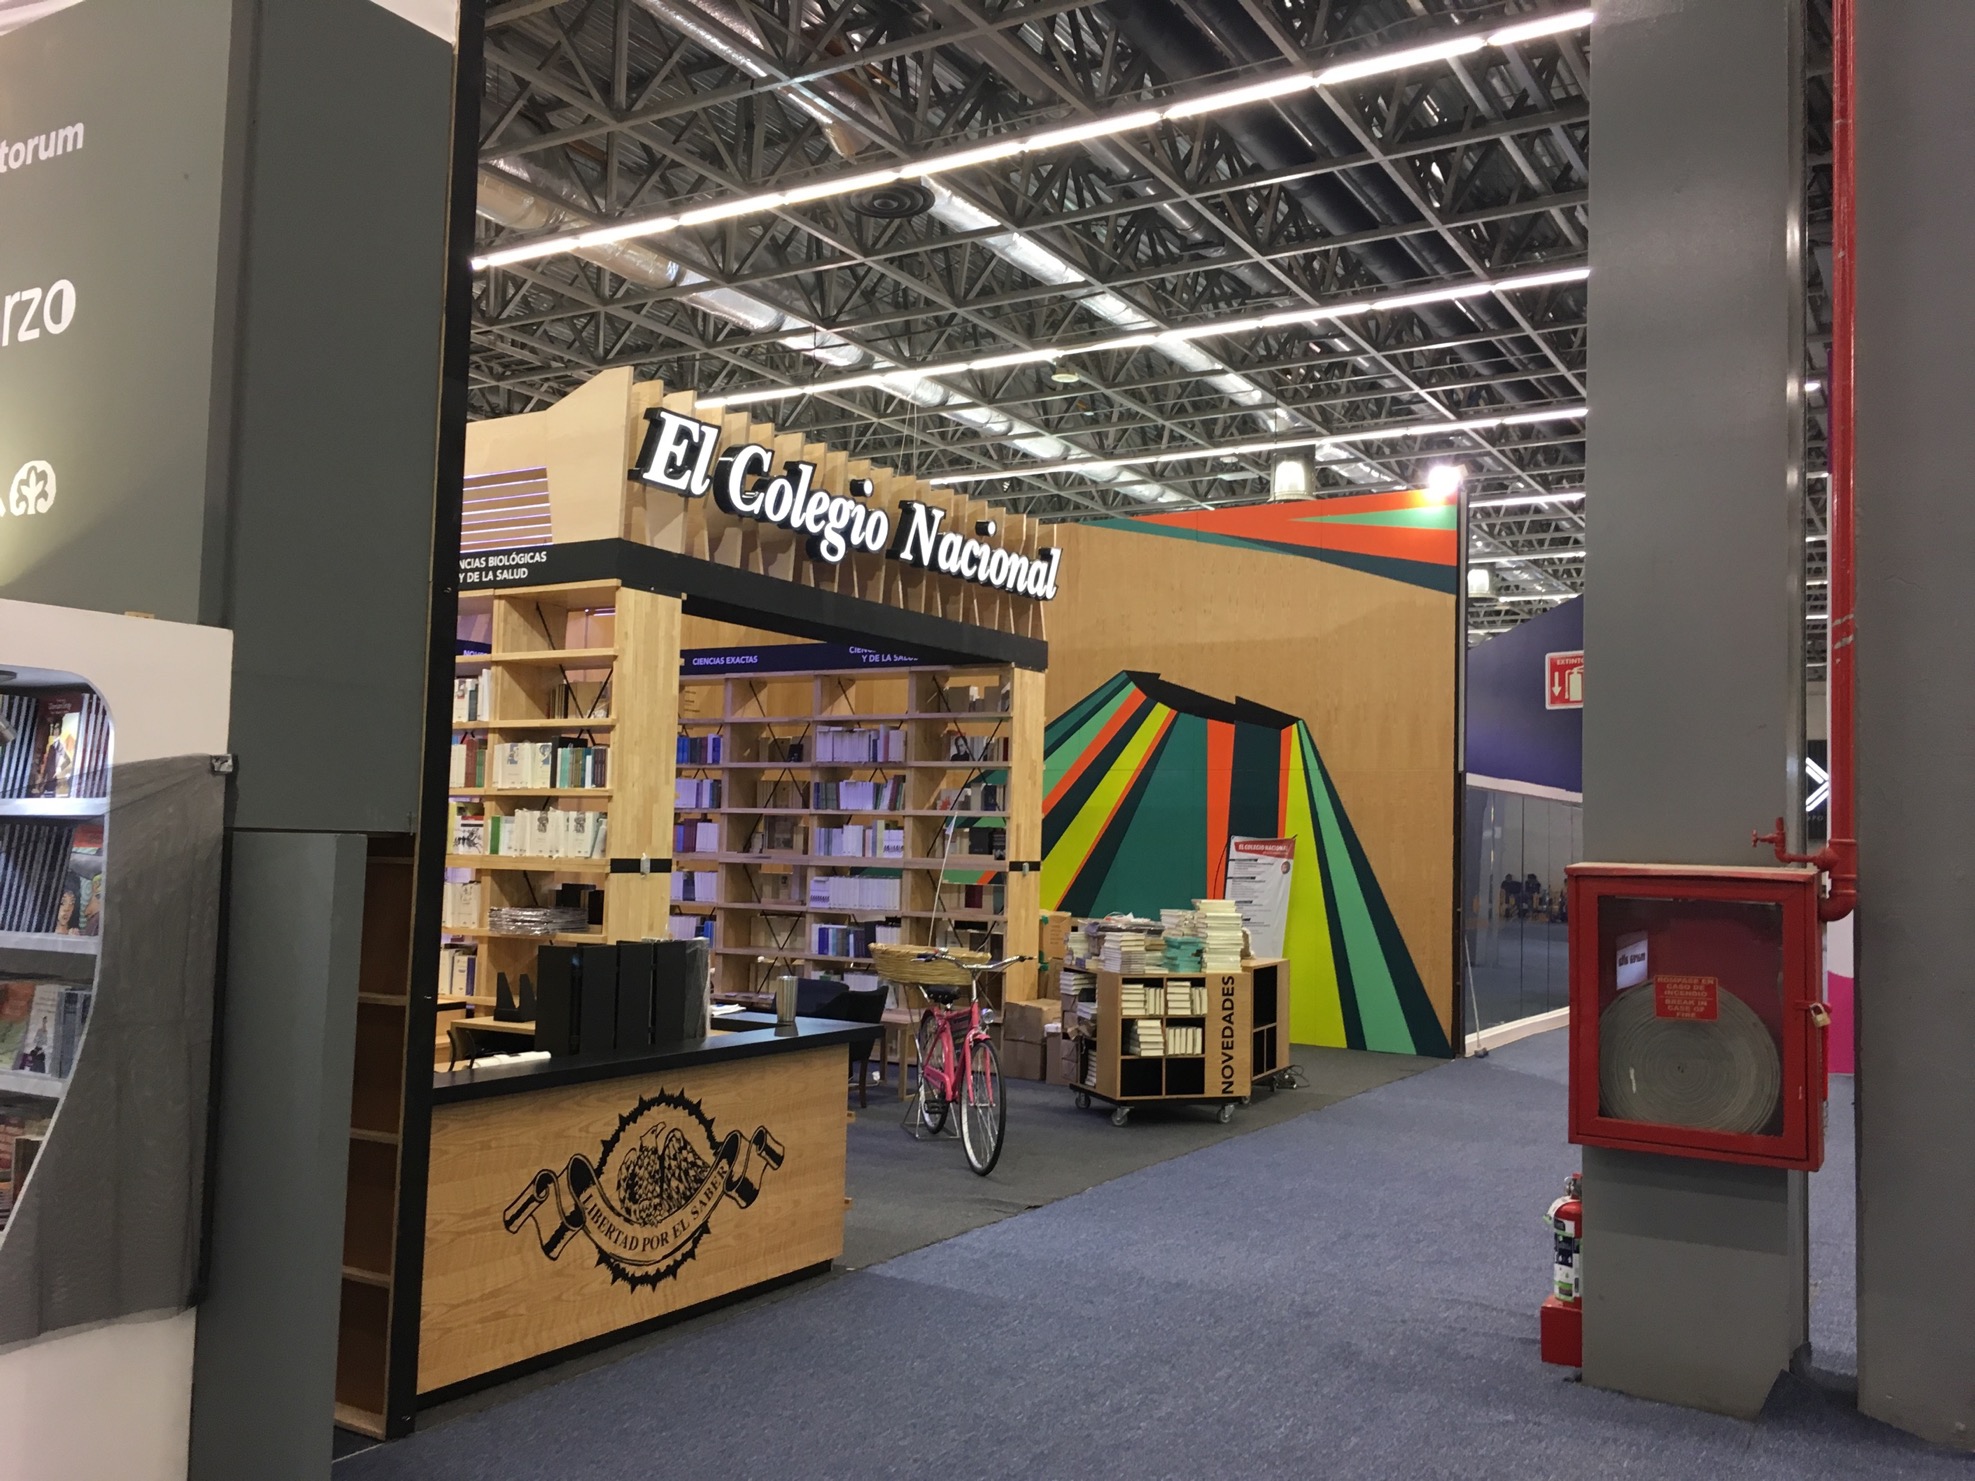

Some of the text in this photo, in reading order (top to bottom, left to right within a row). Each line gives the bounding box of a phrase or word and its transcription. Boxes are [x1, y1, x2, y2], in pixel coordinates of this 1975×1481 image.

[637, 408, 1064, 600] El Colegio Nacional
[488, 551, 547, 567] BIOLÓGICAS
[458, 568, 529, 583] Y DE LA SALUD
[692, 655, 758, 666] CIENCIAS EXACTAS
[861, 654, 868, 663] Y
[868, 654, 880, 662] DE
[881, 653, 892, 662] LA
[1664, 989, 1708, 997] INCENDIO
[1221, 975, 1235, 1095] NOVEDADES
[582, 1165, 729, 1252] LIBERTAD POR EL SABER
